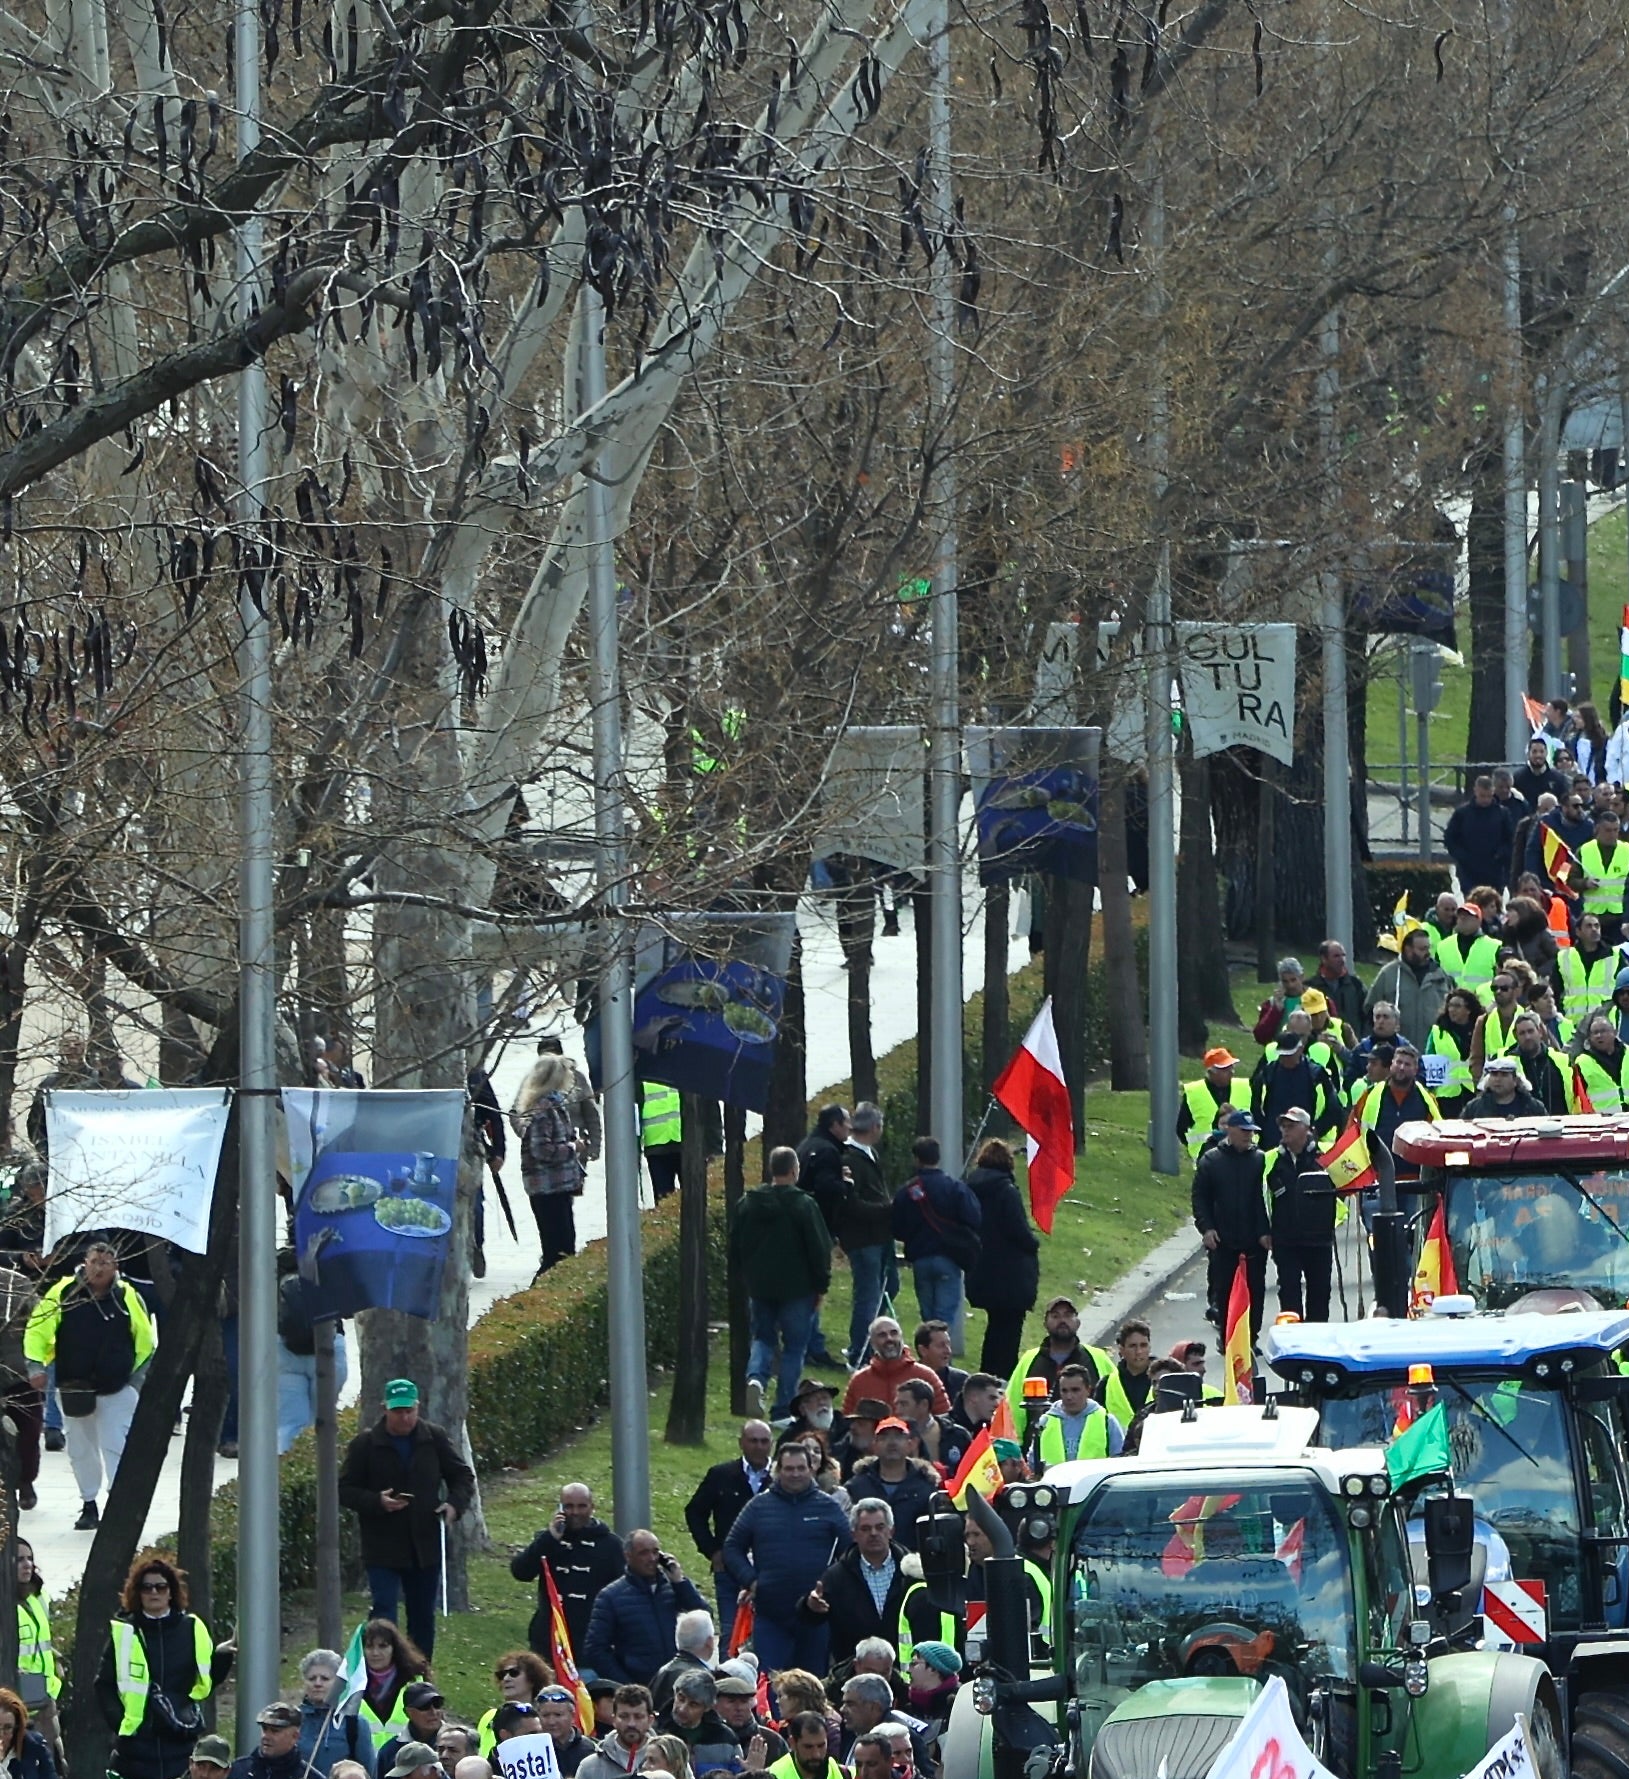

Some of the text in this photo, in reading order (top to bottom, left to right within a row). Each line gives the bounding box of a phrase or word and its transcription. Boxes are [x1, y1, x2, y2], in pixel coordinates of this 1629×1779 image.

[1187, 633, 1276, 664] CUL
[1203, 662, 1262, 692] TU
[1237, 692, 1288, 738] RA
